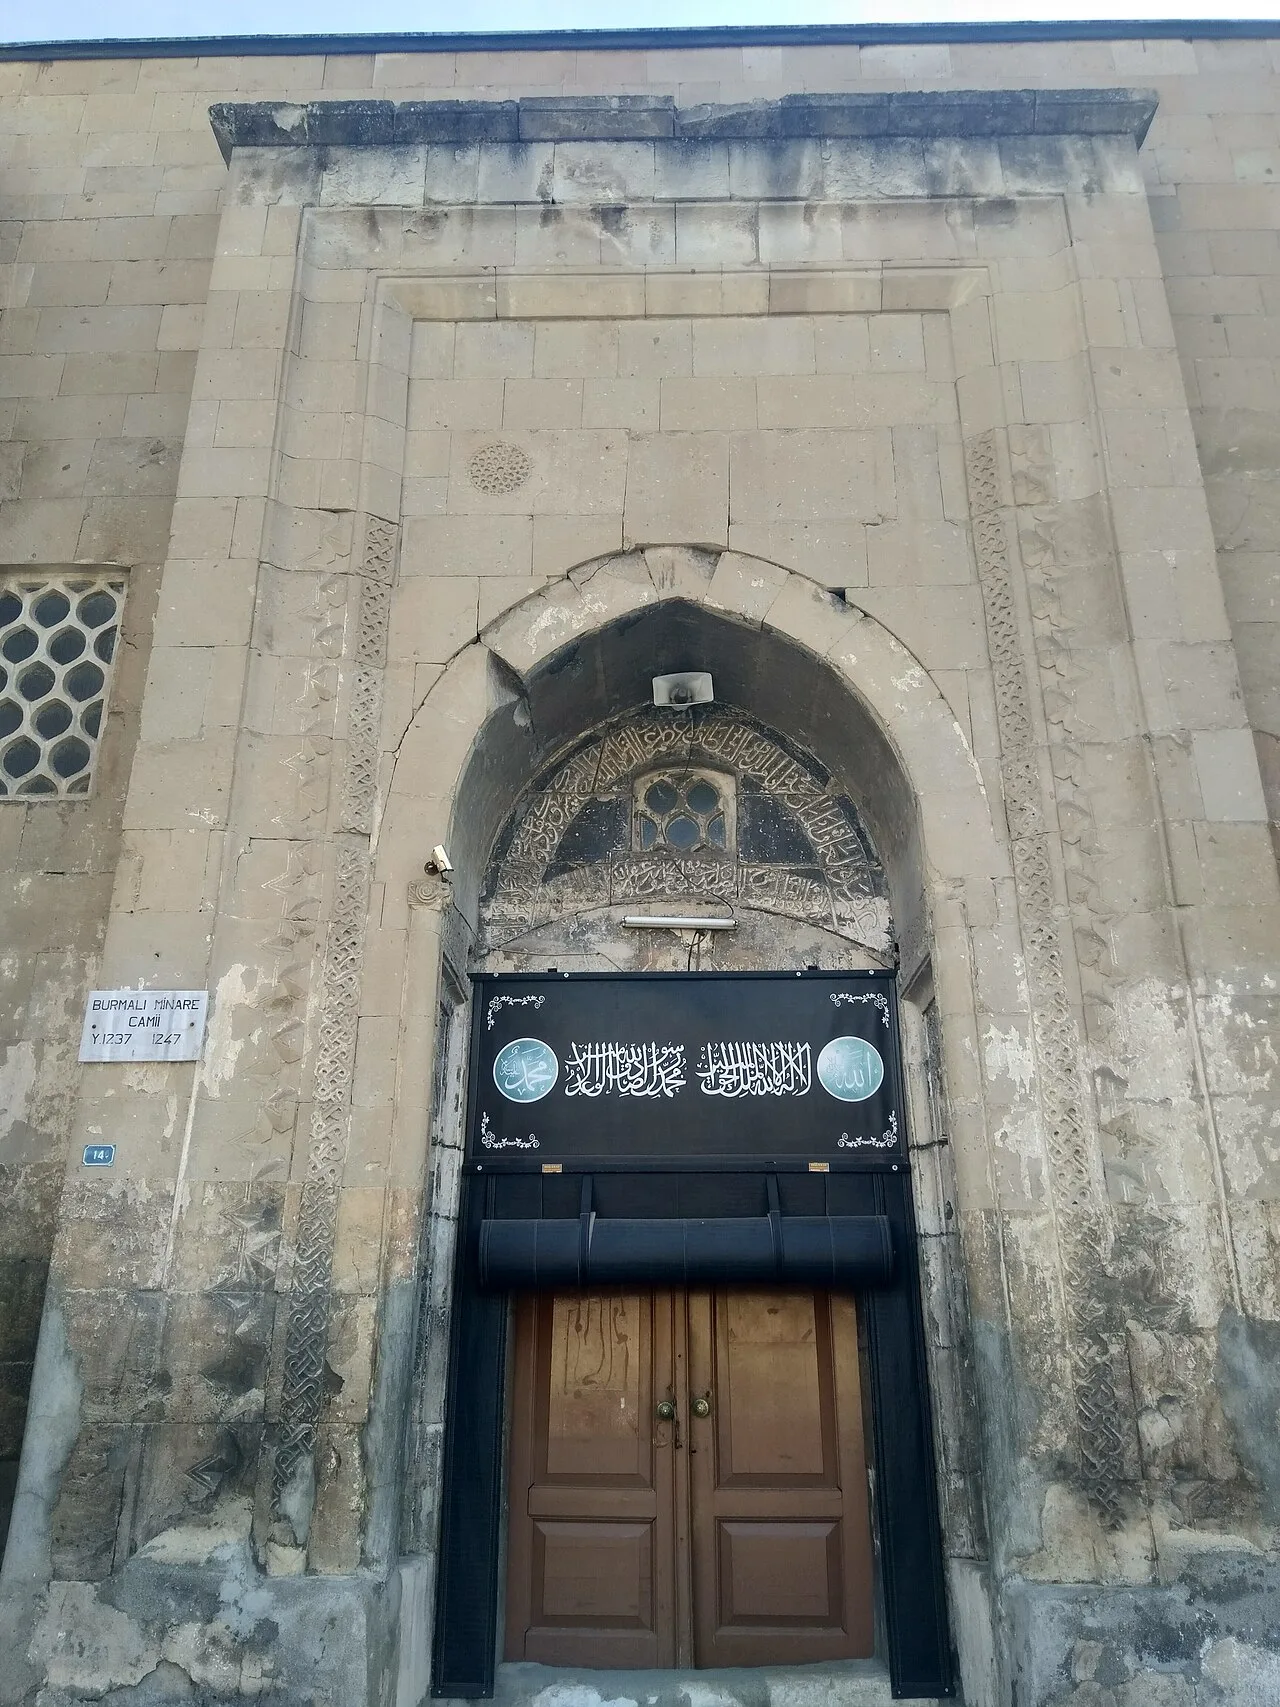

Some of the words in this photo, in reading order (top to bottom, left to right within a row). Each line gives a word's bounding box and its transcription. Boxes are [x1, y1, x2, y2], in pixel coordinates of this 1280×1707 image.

[92, 999, 147, 1011] BURMALI
[153, 997, 200, 1010] MİNARE
[128, 1014, 161, 1028] CAMİİ
[152, 1033, 181, 1045] 1247
